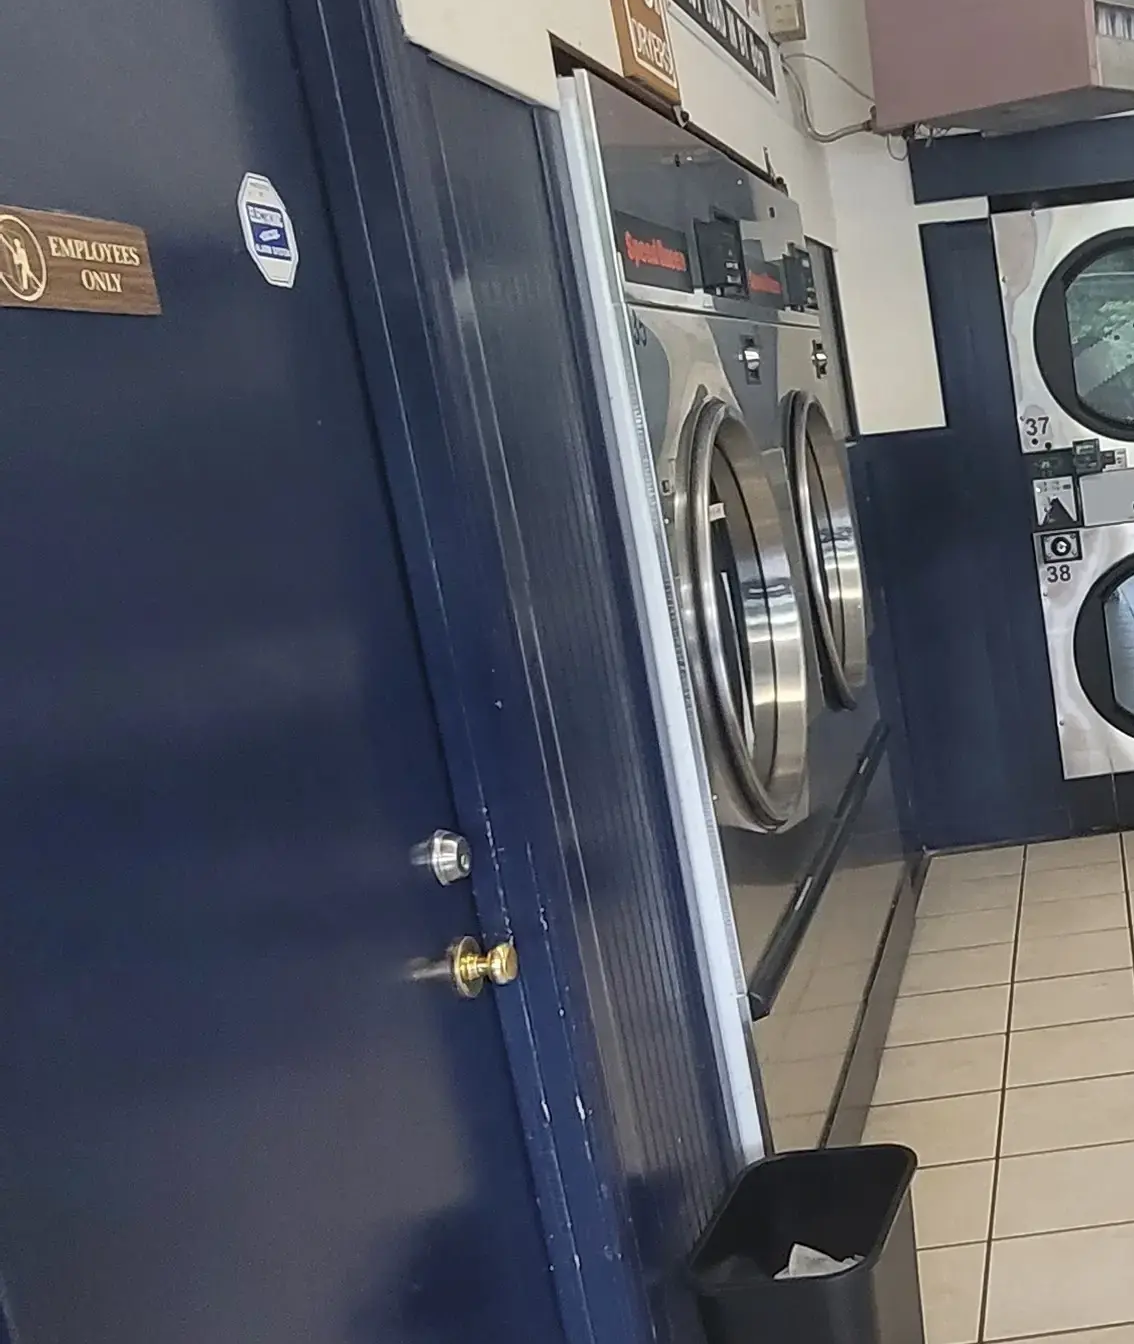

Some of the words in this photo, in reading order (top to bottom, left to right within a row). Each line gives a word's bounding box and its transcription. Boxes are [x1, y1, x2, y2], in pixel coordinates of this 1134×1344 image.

[48, 235, 140, 267] EMPLOYEES
[81, 270, 123, 293] ONLY
[1025, 416, 1049, 436] 37
[1046, 564, 1071, 583] 38
